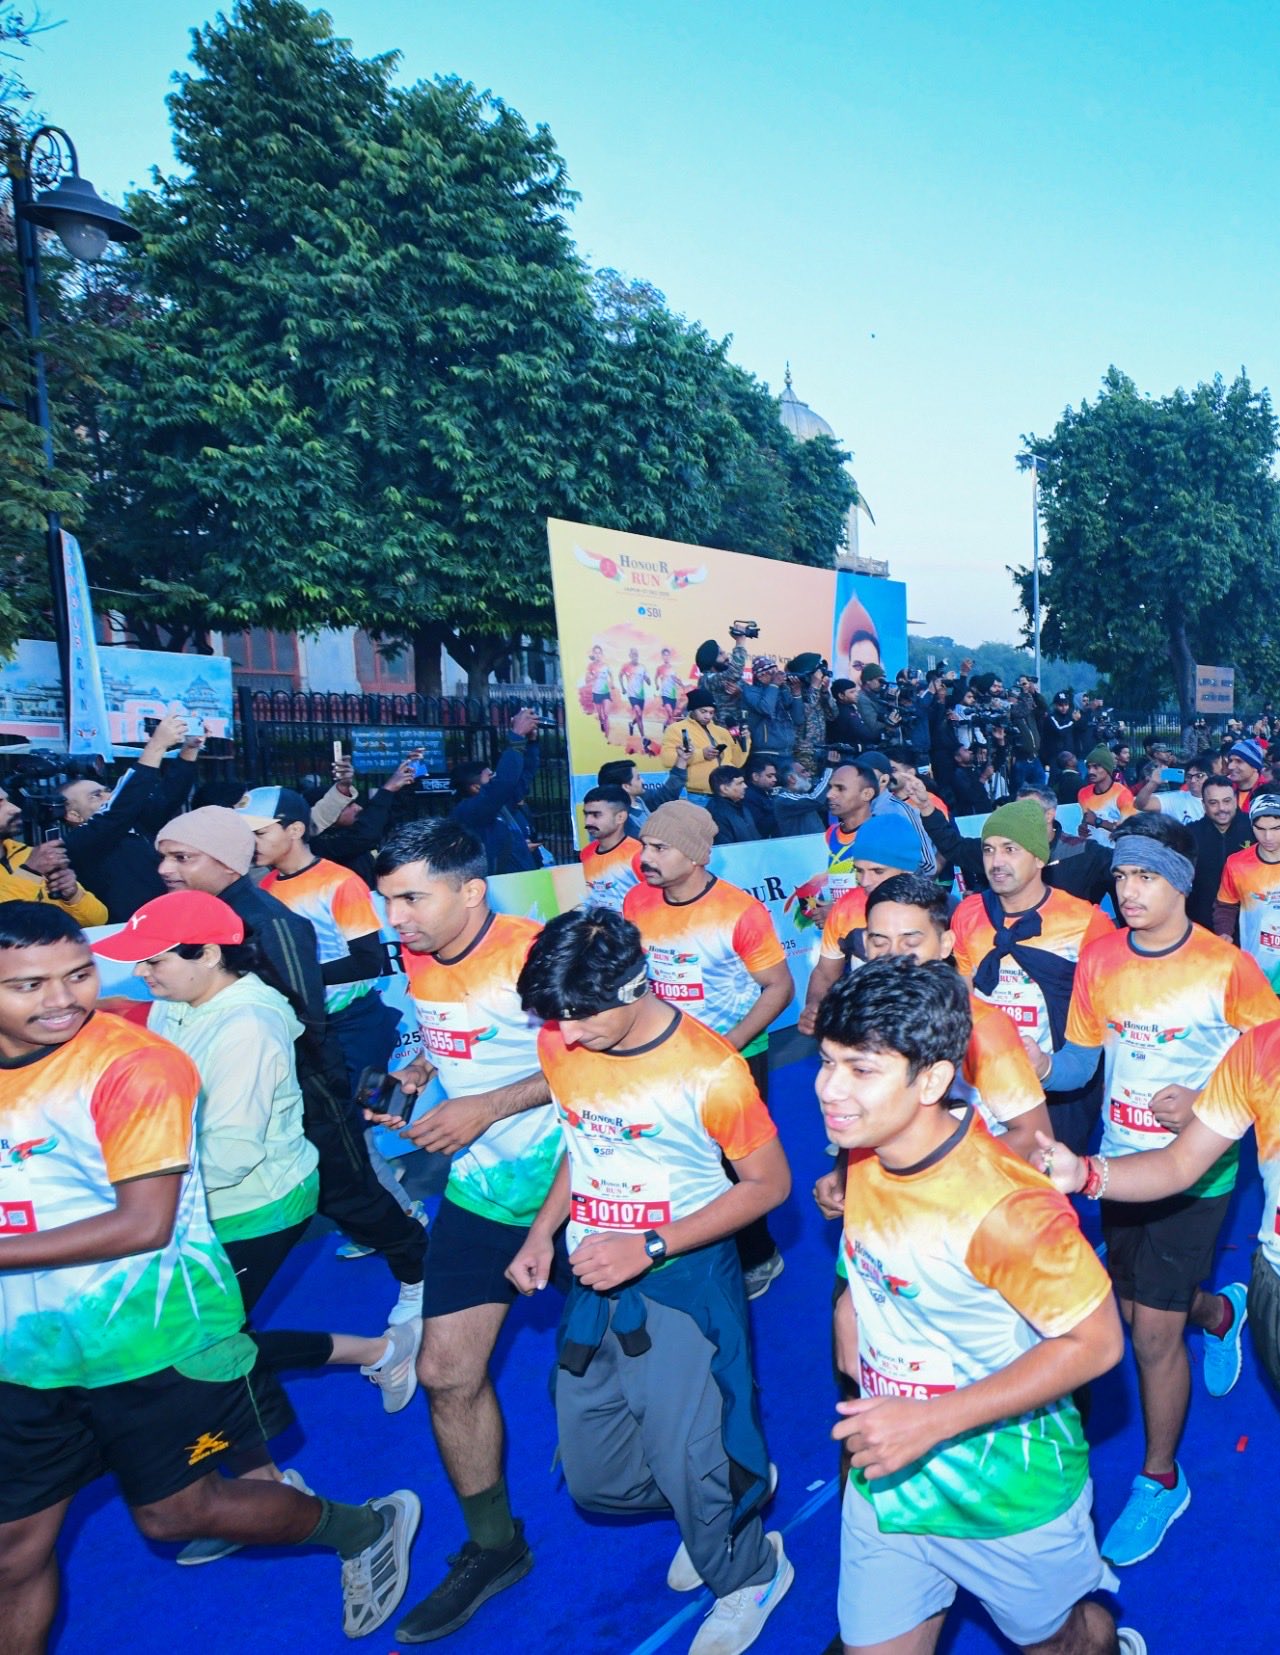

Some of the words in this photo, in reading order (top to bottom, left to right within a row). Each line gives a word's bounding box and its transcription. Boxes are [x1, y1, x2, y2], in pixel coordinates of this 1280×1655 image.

[619, 555, 668, 574] HONOUR
[631, 572, 660, 587] RUN
[646, 607, 661, 618] SBI
[653, 982, 689, 998] 11003
[1123, 1020, 1158, 1033] HONOUR
[1130, 1031, 1151, 1041] RUN
[582, 1109, 624, 1127] HONOUR
[1127, 1106, 1161, 1128] 106
[591, 1123, 616, 1135] RUN
[588, 1199, 646, 1223] 10107
